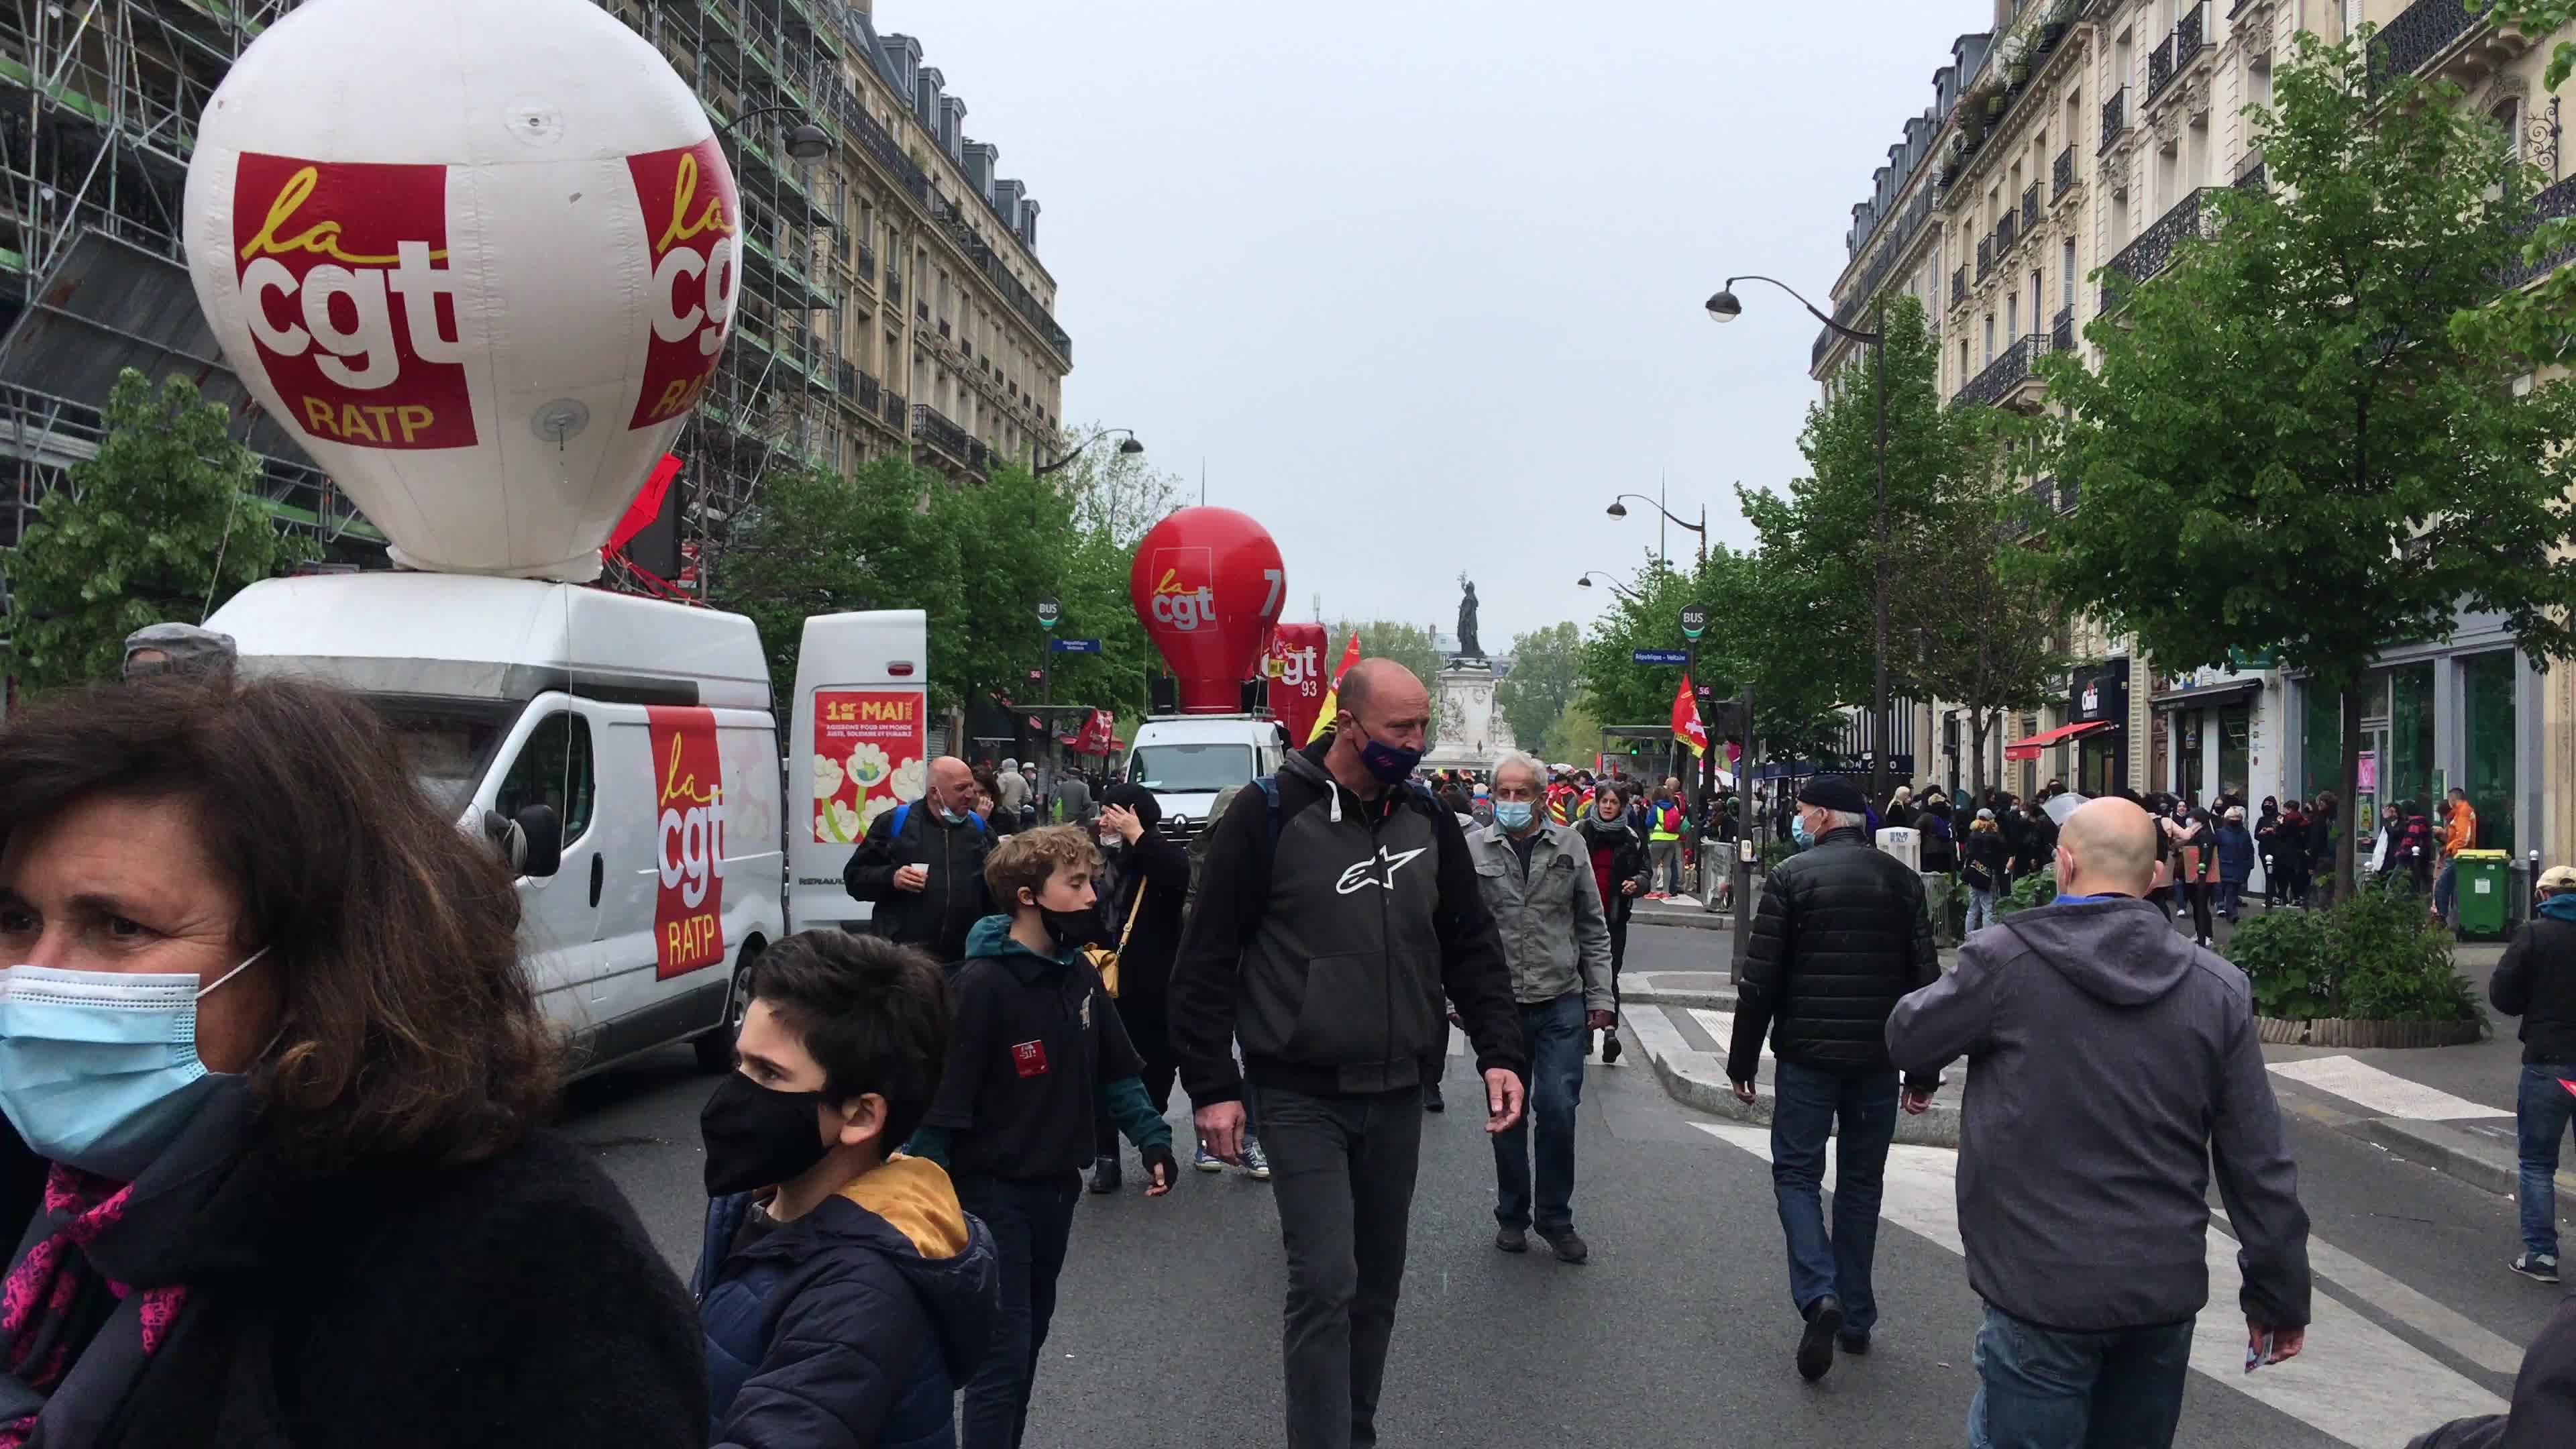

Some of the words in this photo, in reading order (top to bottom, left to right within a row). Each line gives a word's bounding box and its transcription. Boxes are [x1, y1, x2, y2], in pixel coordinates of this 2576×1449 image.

[241, 166, 400, 264] la
[656, 152, 736, 254] la
[241, 239, 468, 389] cgt
[651, 236, 735, 356] cg
[649, 364, 715, 418] RA
[303, 396, 435, 443] RATP
[1153, 568, 1199, 596] la
[1039, 603, 1057, 613] BUS
[1152, 586, 1217, 631] cgt
[1683, 612, 1704, 623] BUS
[861, 701, 904, 720] MAI
[1301, 680, 1318, 697] 93
[1698, 687, 1710, 695] 56
[660, 732, 724, 807] la
[1868, 760, 1897, 769] CO
[657, 784, 724, 908] cgt
[799, 877, 845, 885] RENAUL
[668, 913, 715, 966] RATP
